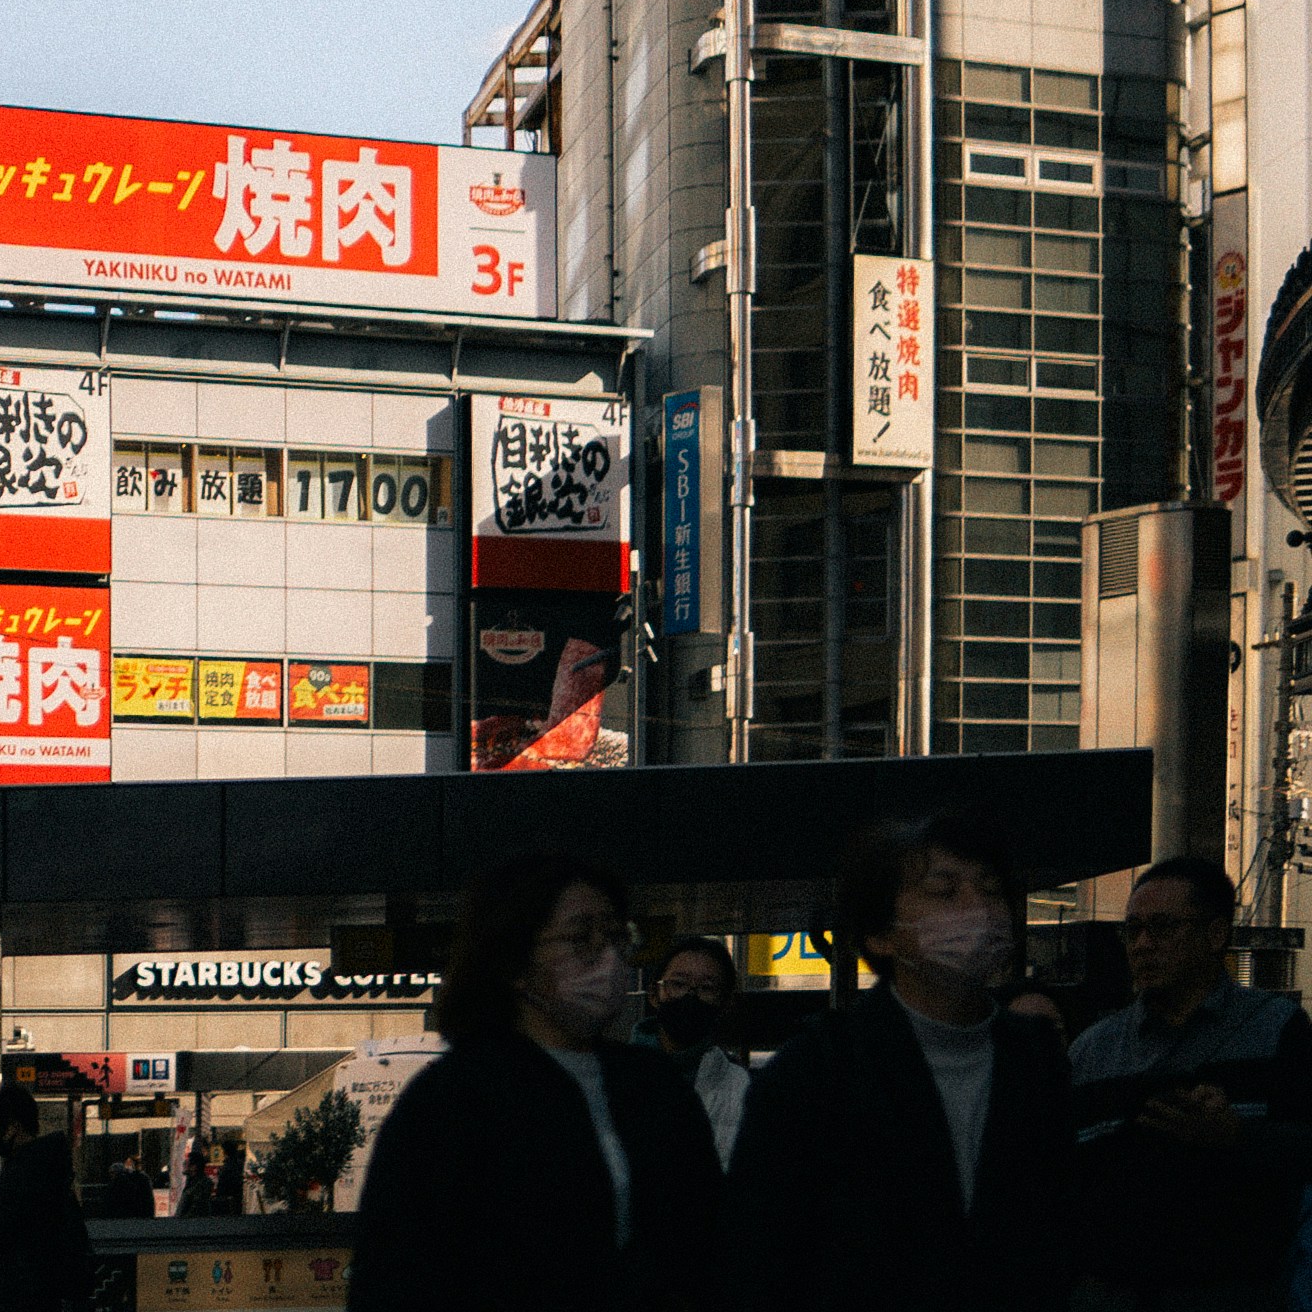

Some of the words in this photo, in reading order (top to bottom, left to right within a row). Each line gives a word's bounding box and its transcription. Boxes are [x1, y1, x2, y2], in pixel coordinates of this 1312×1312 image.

[212, 134, 413, 267] 焼肉
[83, 257, 177, 283] YAKINIKU
[183, 268, 207, 286] no
[214, 267, 291, 291] WATAMI
[471, 245, 524, 297] 3F
[897, 265, 920, 401] 特選焼肉
[79, 372, 108, 397] 4F
[1216, 289, 1244, 502] ジャンカラ
[603, 402, 628, 427] 4F
[672, 411, 694, 430] SBI
[500, 423, 610, 482] 目利きの
[116, 466, 266, 507] 飲み放題
[500, 472, 588, 527] 銀次
[673, 448, 692, 622] SBI新生銀行
[116, 675, 188, 701] ランチ
[205, 671, 234, 688] 焼肉
[246, 671, 276, 689] 食べ
[205, 690, 234, 707] 定食
[246, 690, 277, 709] 放題
[20, 747, 36, 757] no
[40, 745, 91, 758] WATAMI
[135, 961, 324, 987] STARBUCKS
